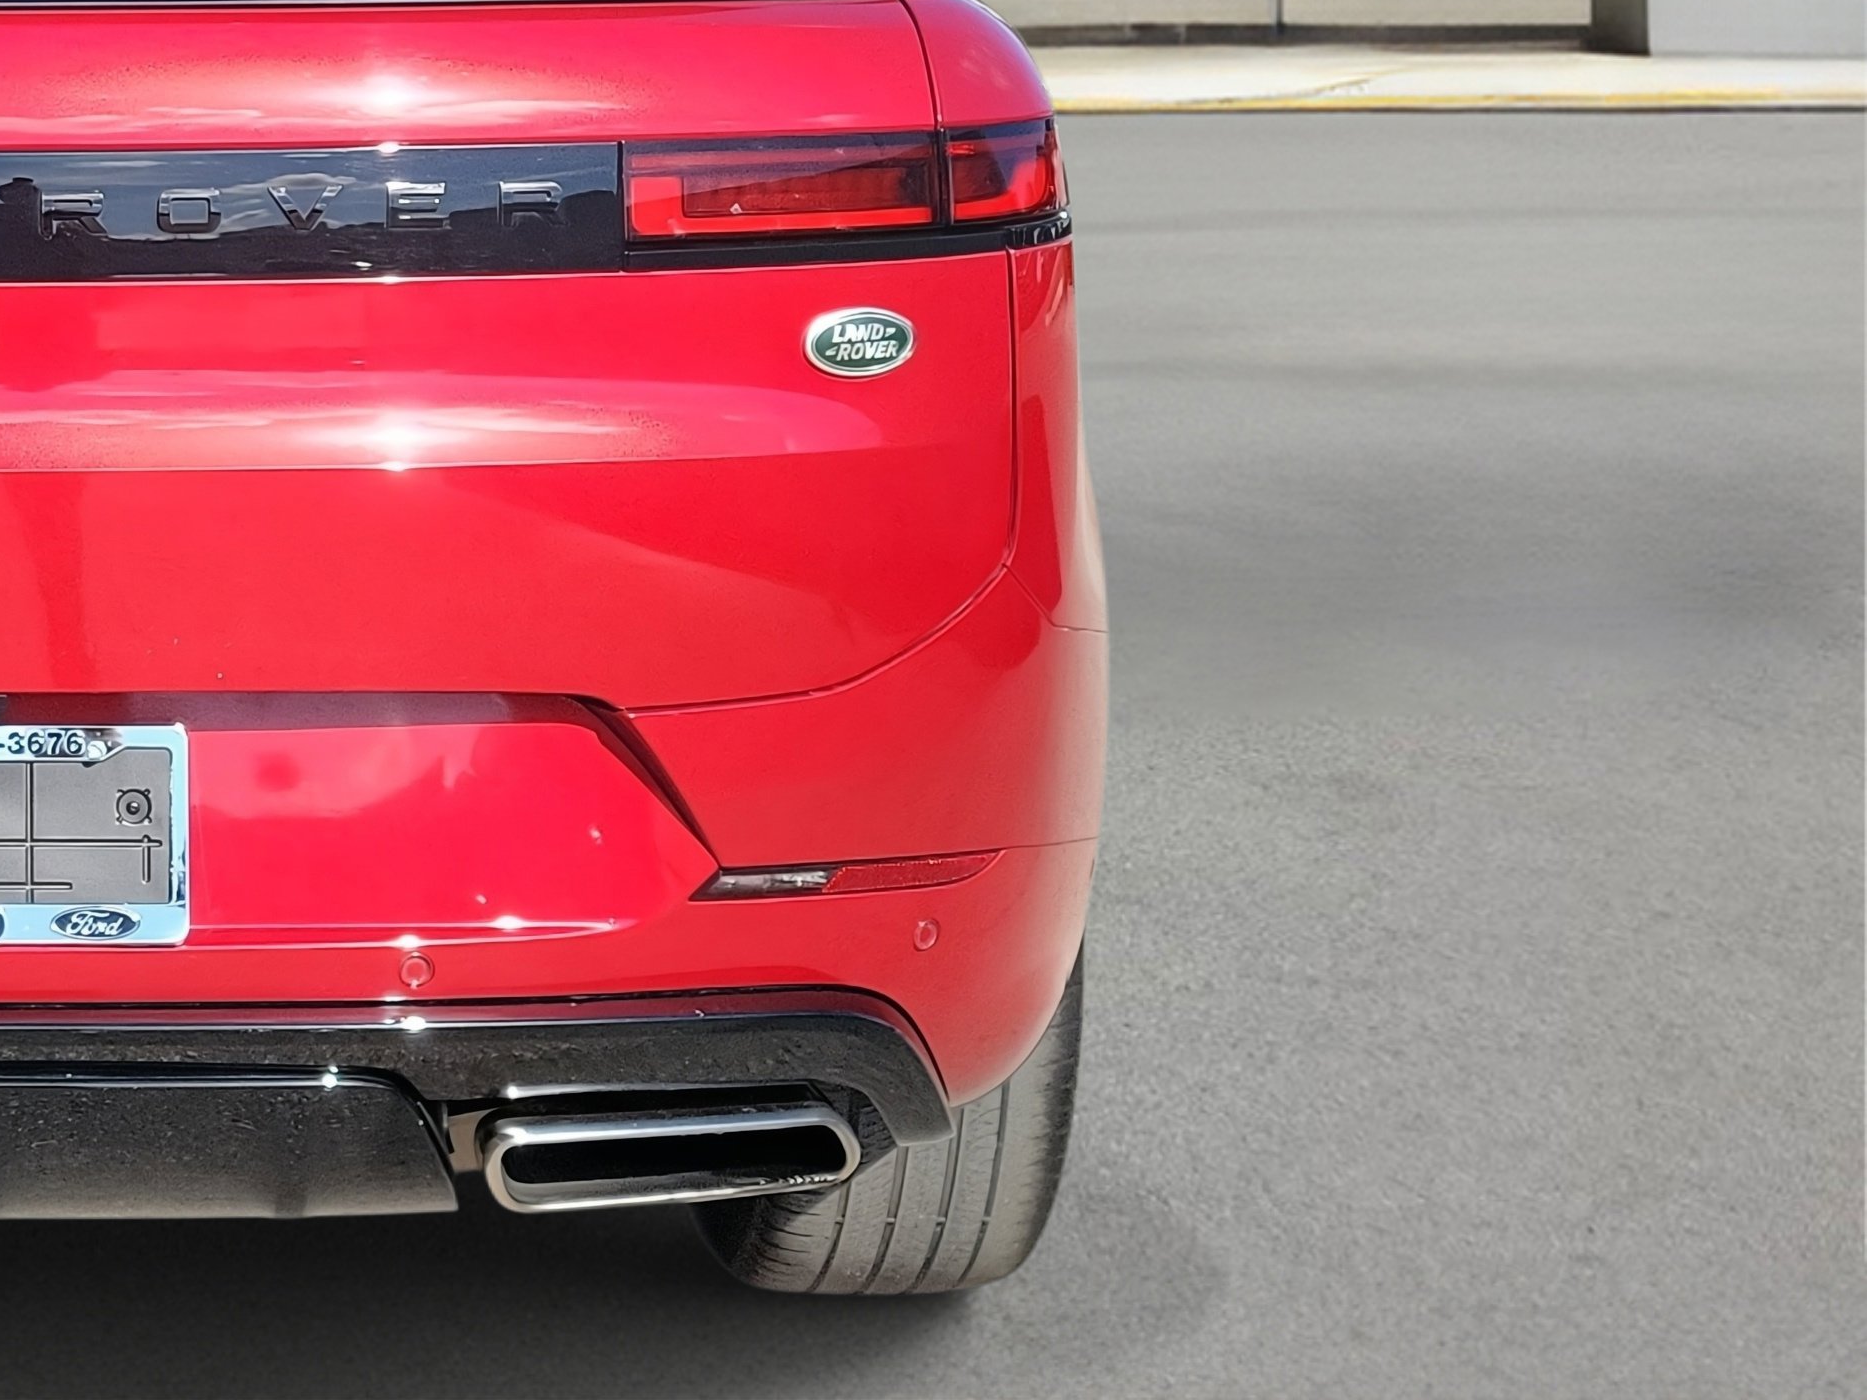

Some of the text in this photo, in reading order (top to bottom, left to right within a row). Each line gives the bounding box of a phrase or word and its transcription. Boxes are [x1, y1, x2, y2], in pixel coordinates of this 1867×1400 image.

[37, 180, 570, 240] ROVER
[832, 323, 884, 343] LAND
[836, 341, 900, 361] ROVER
[64, 911, 128, 937] Ford
